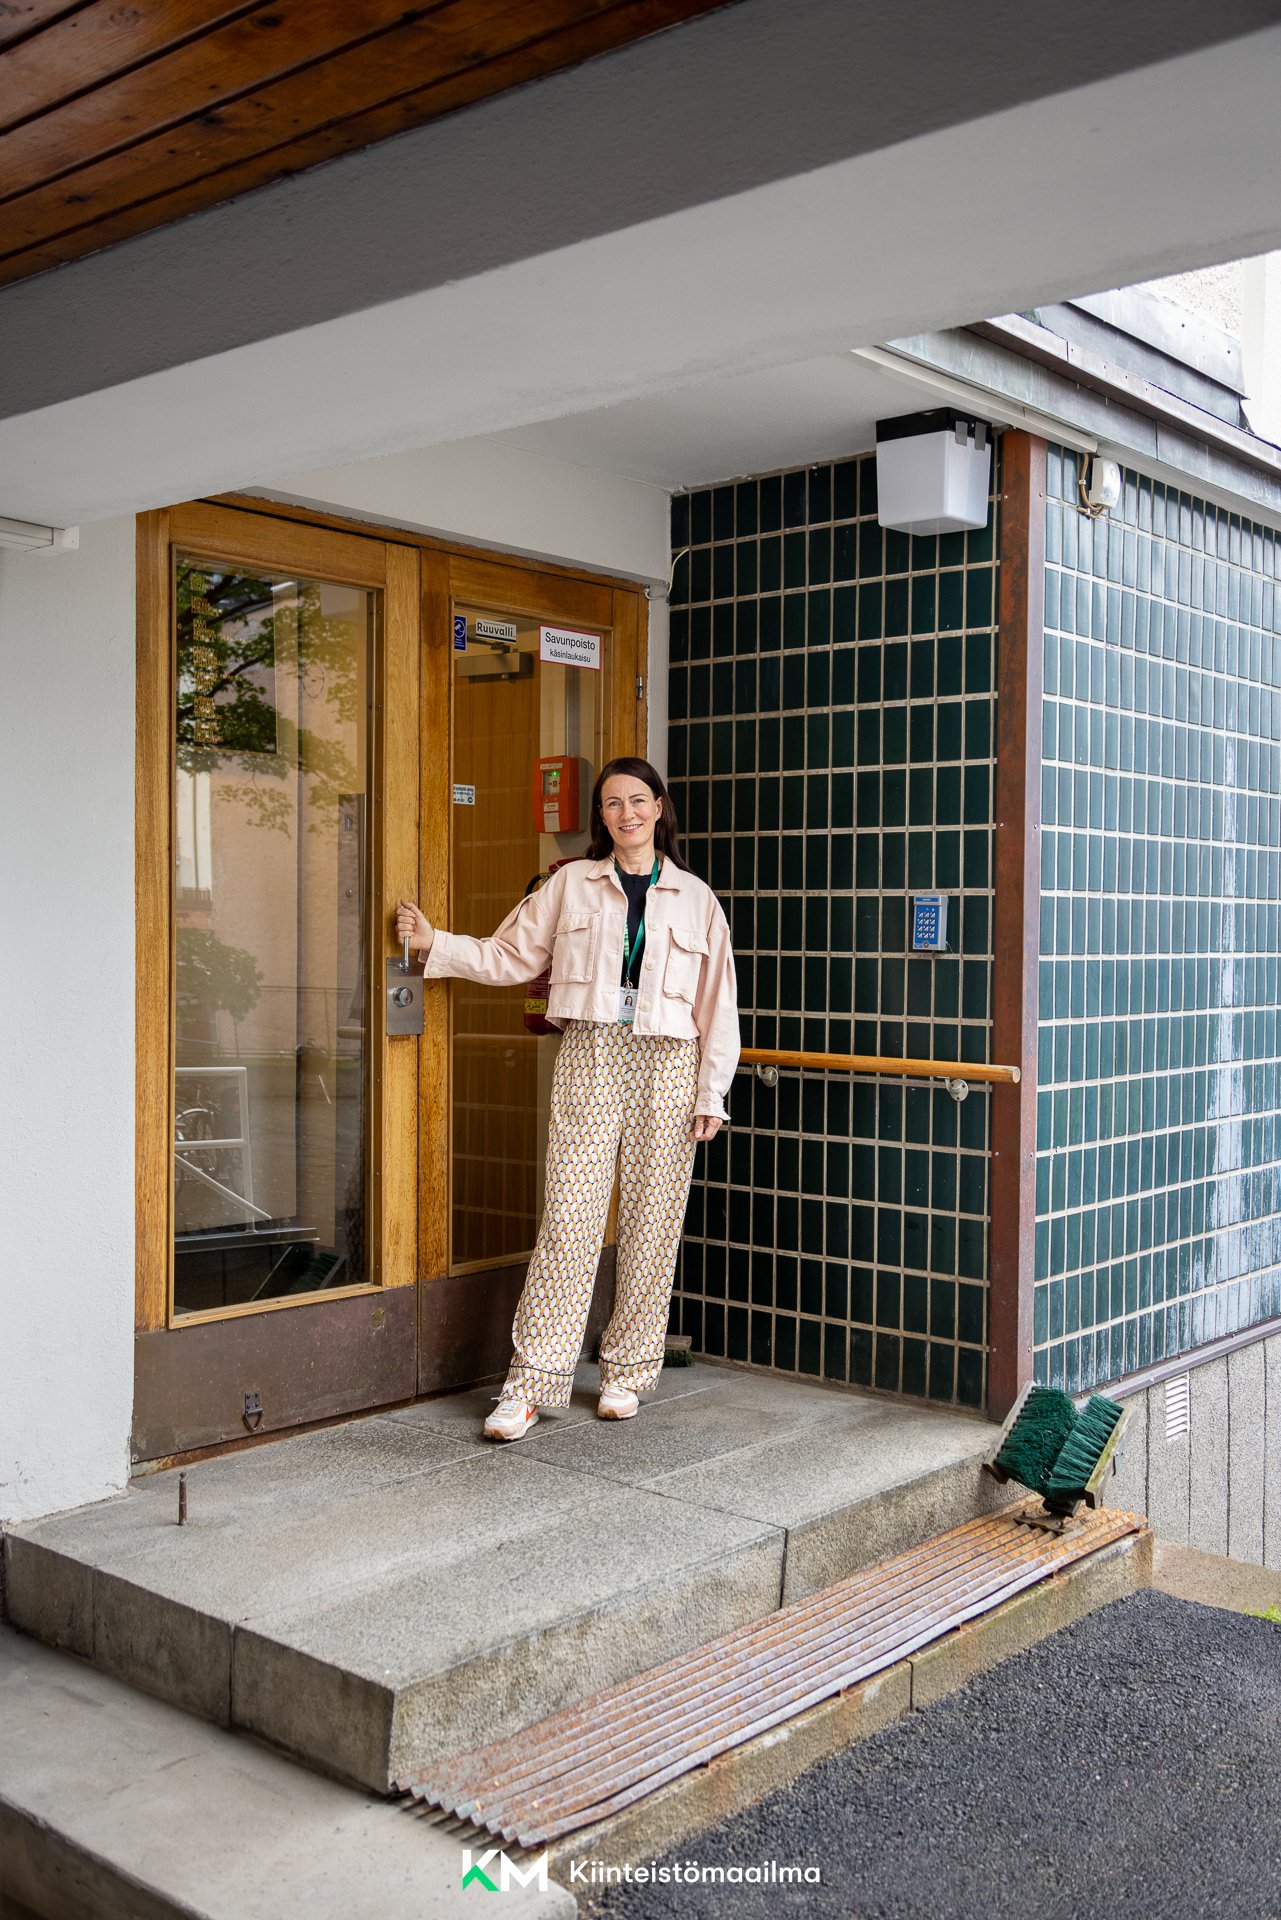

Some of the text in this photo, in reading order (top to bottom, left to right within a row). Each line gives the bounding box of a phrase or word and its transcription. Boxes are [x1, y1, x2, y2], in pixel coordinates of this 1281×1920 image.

[177, 622, 183, 630] 6
[477, 622, 513, 638] Ruuvalli
[545, 631, 596, 651] Savunpoisto
[549, 648, 591, 663] käsinlaukaisu
